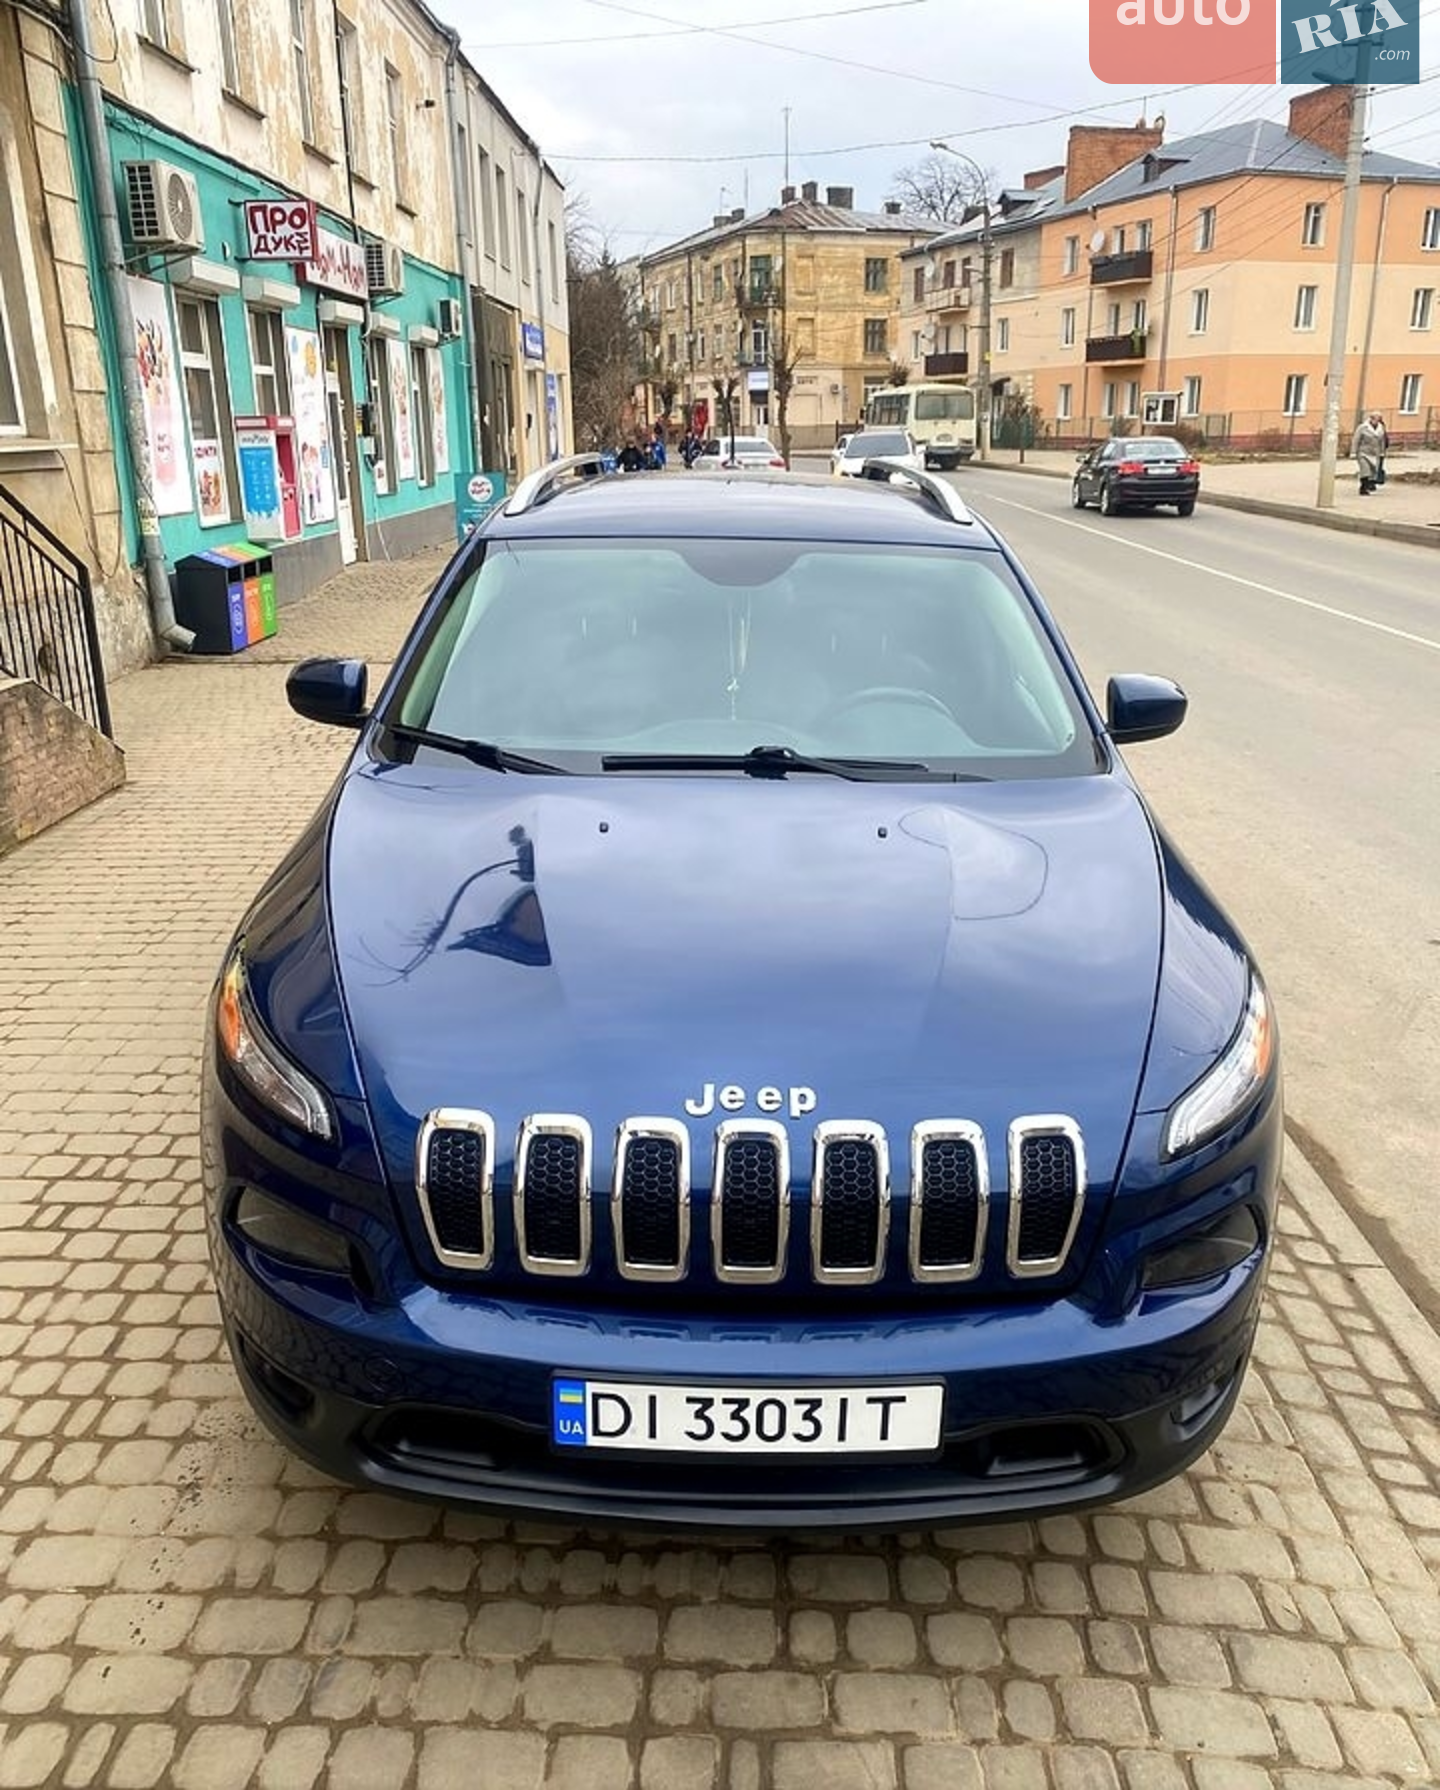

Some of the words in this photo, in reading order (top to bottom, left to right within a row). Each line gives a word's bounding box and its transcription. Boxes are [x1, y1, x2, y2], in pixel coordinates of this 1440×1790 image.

[248, 204, 308, 235] ПРО
[684, 1083, 817, 1119] Jeep
[558, 1420, 585, 1436] UA
[591, 1392, 657, 1440] DI
